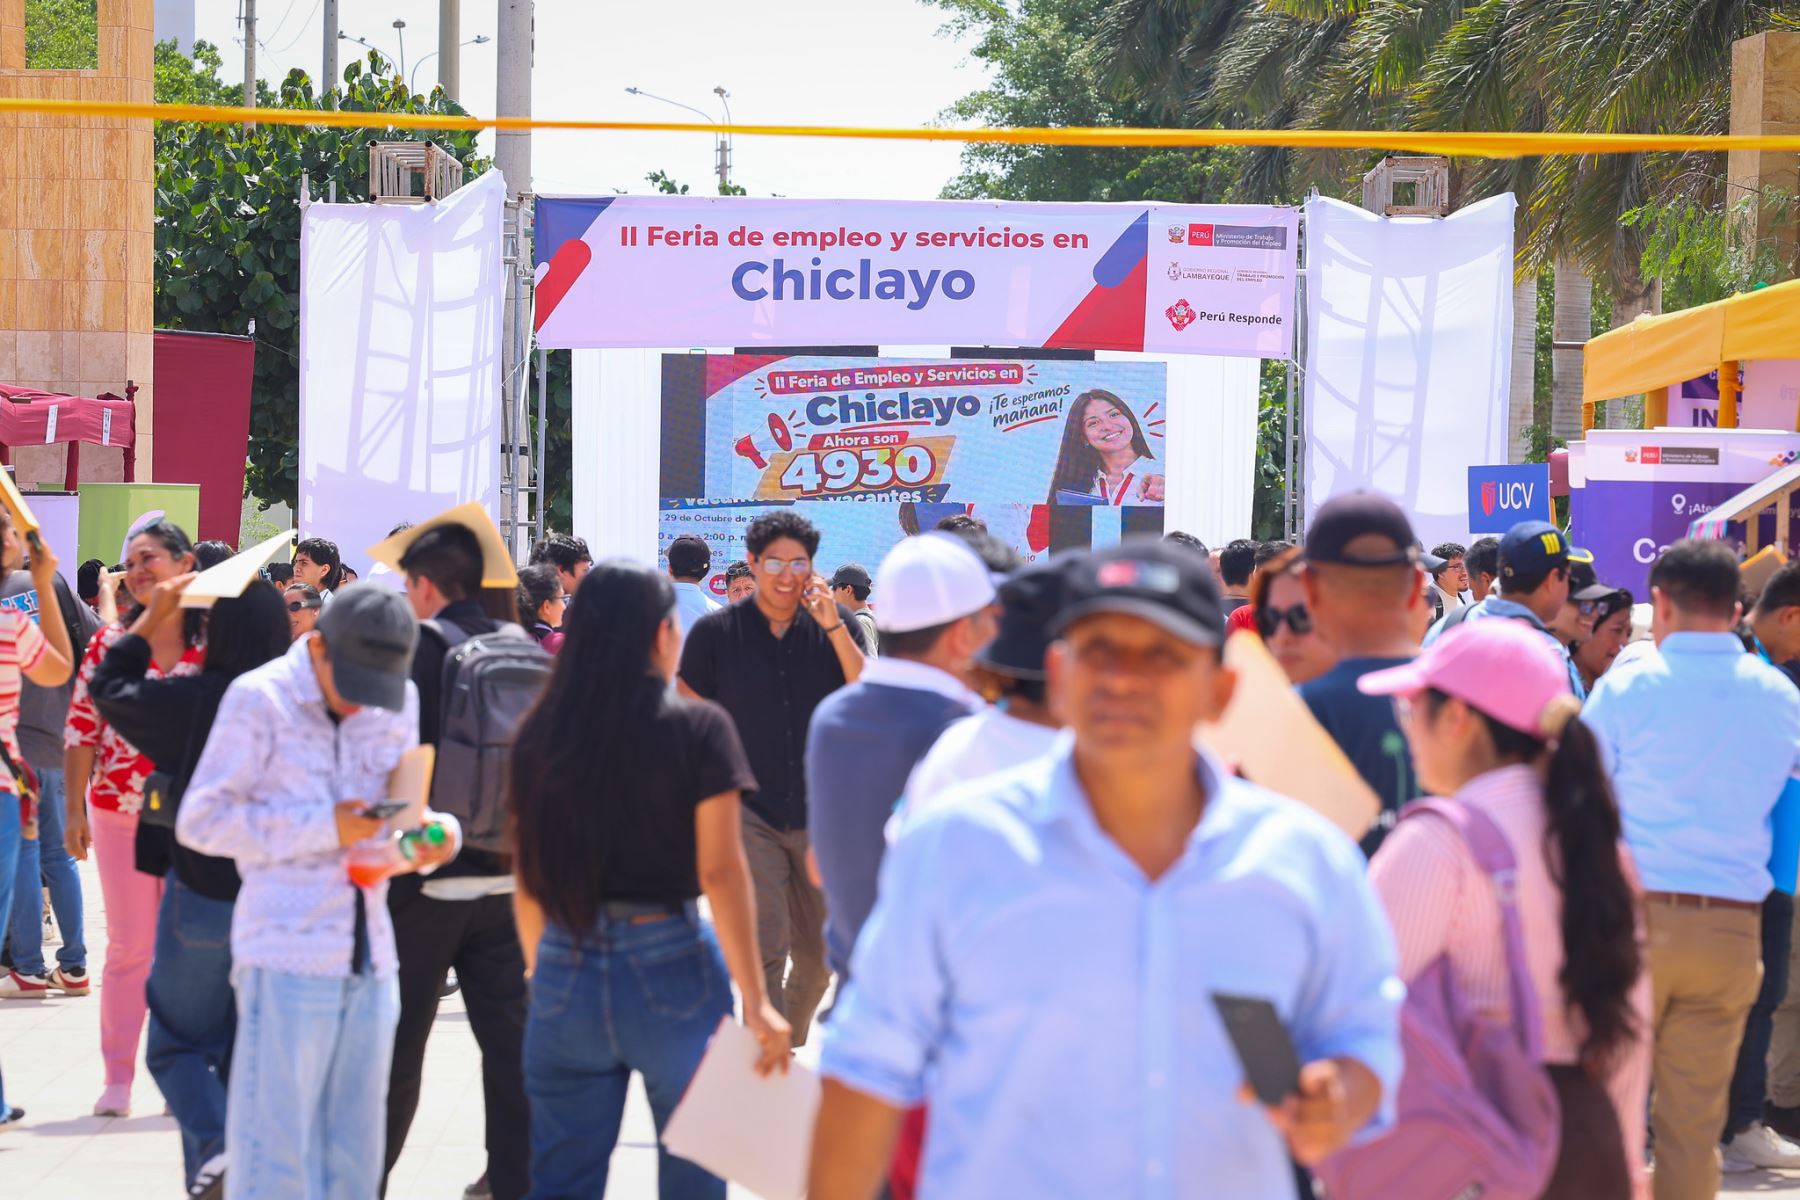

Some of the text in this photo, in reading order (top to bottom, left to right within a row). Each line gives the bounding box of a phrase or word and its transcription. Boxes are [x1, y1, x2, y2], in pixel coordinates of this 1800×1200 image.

[620, 223, 1089, 252] II Feria de empleo y servicios en
[1191, 231, 1210, 239] PERÚ
[1216, 233, 1245, 241] Ministerio
[1254, 234, 1274, 242] Trabajo
[731, 257, 976, 311] Chiclayo
[1182, 272, 1230, 281] LAMBAYEQUE
[1200, 311, 1282, 326] Perú Responde
[775, 367, 1018, 389] II Feria de Empleo y Servicios en
[806, 391, 981, 427] Chiclayo
[989, 384, 1071, 415] ¡Te esperamos
[993, 397, 1064, 428] mañana!
[823, 433, 899, 448] Ahora son
[779, 444, 937, 494] 4930
[1500, 482, 1534, 510] UCV
[665, 513, 677, 521] 29
[680, 513, 692, 522] de
[694, 514, 733, 522] Octubre
[735, 514, 748, 522] de
